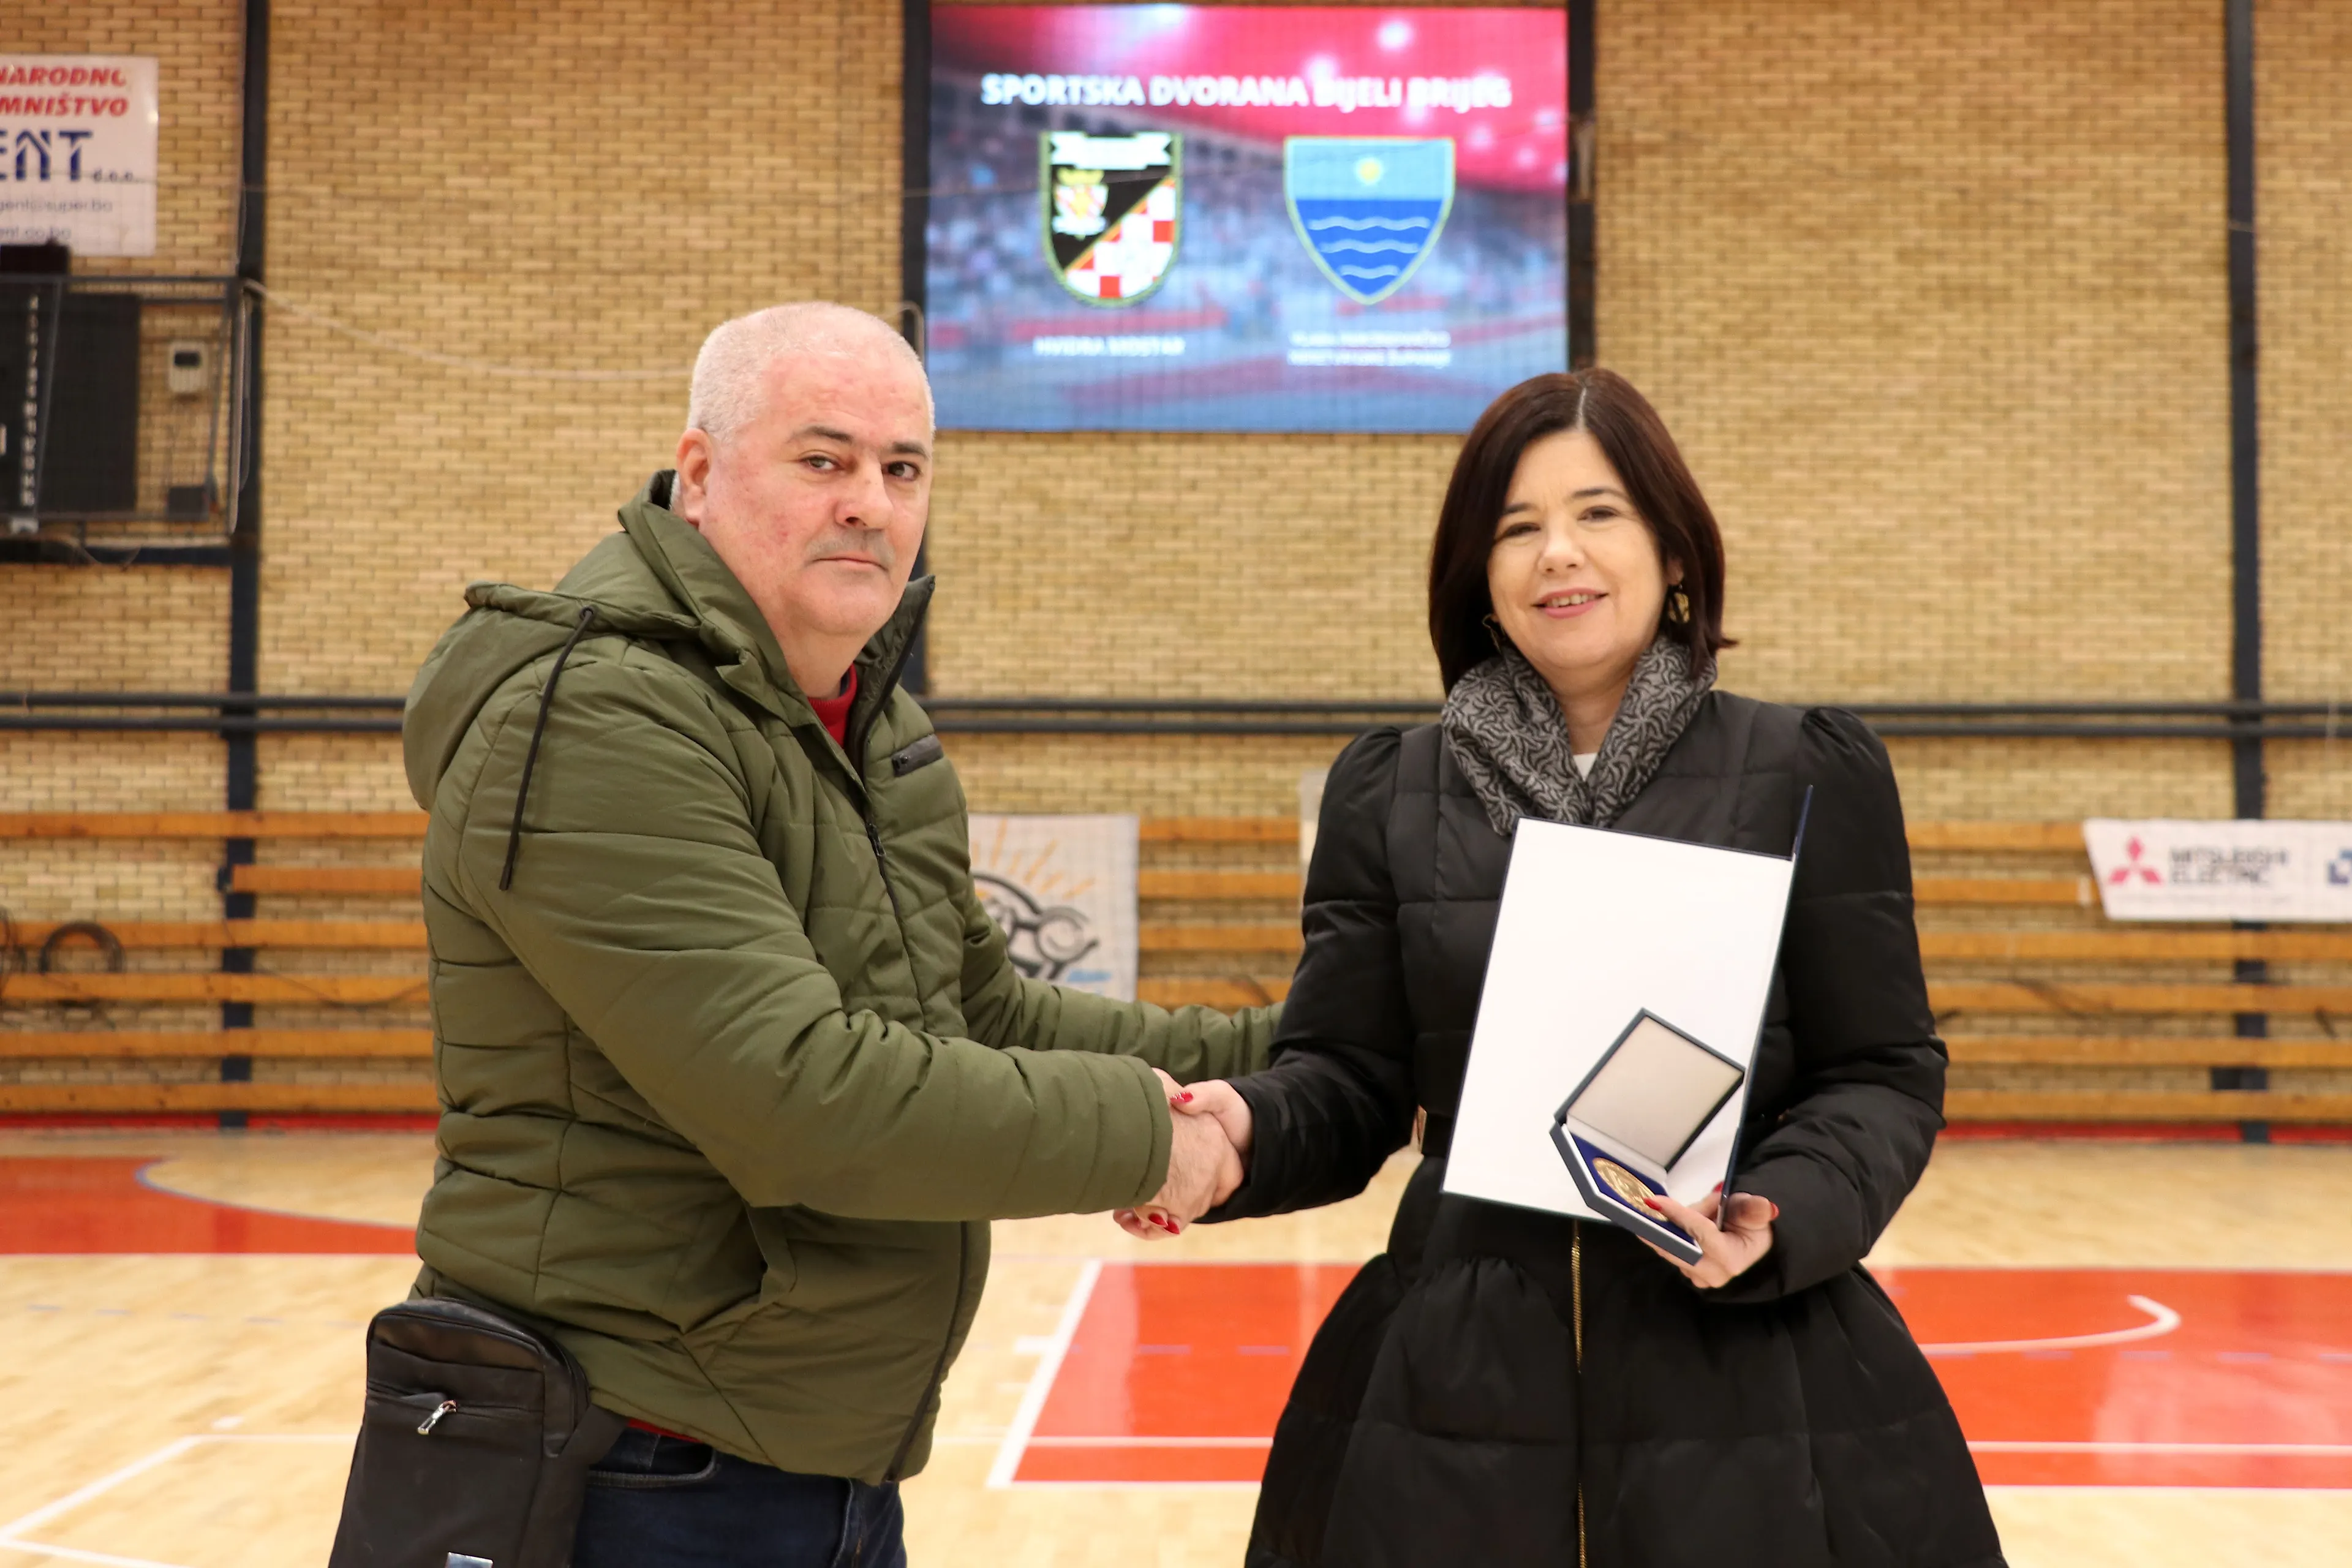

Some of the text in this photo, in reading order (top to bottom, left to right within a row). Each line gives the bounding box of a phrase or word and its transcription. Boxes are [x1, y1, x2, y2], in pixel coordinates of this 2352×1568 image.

[981, 74, 1146, 105] SPORTSKA
[1149, 75, 1310, 107] DVORANA
[1314, 76, 1403, 113] BIJELI
[0, 130, 93, 181] NT
